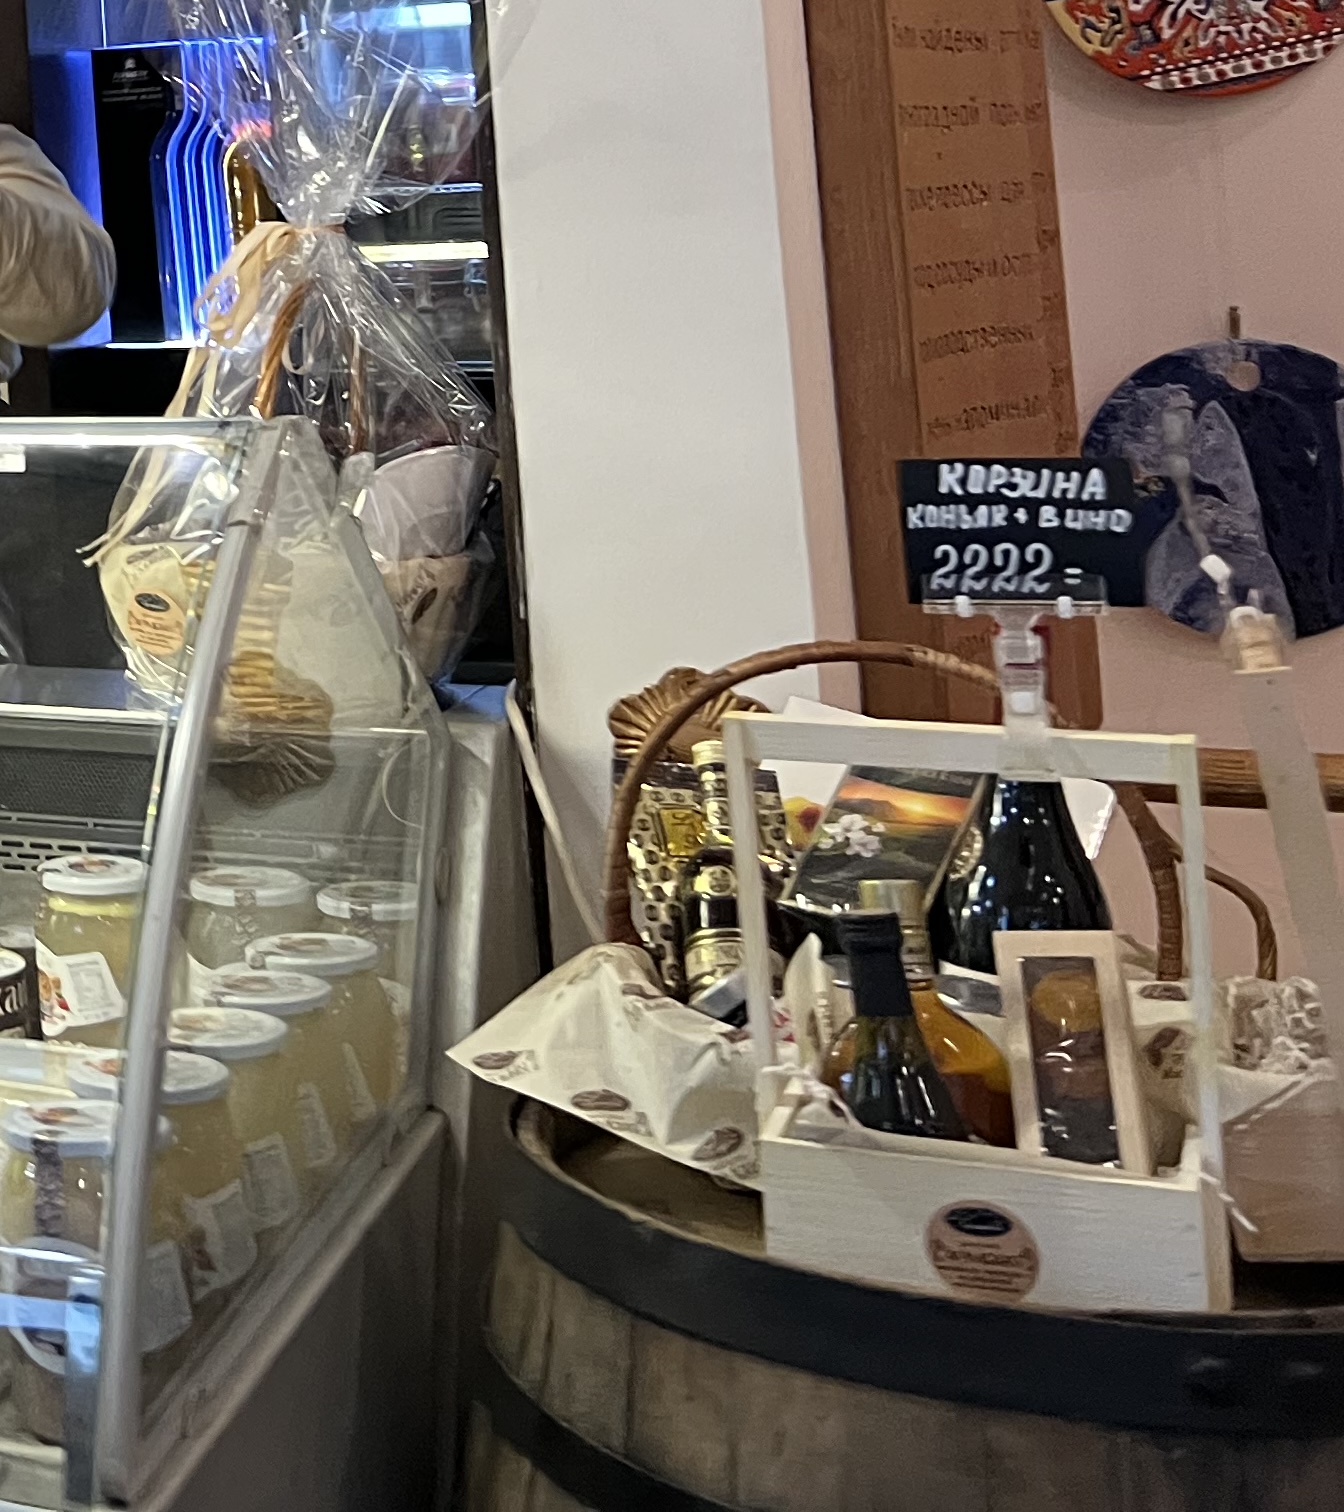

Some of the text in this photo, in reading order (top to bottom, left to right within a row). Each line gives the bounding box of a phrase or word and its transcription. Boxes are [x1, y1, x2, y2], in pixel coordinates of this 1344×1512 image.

[937, 462, 1107, 501] КОРЗИНА
[905, 503, 1010, 530] КОНЬЯК
[929, 542, 1054, 593] 2222
